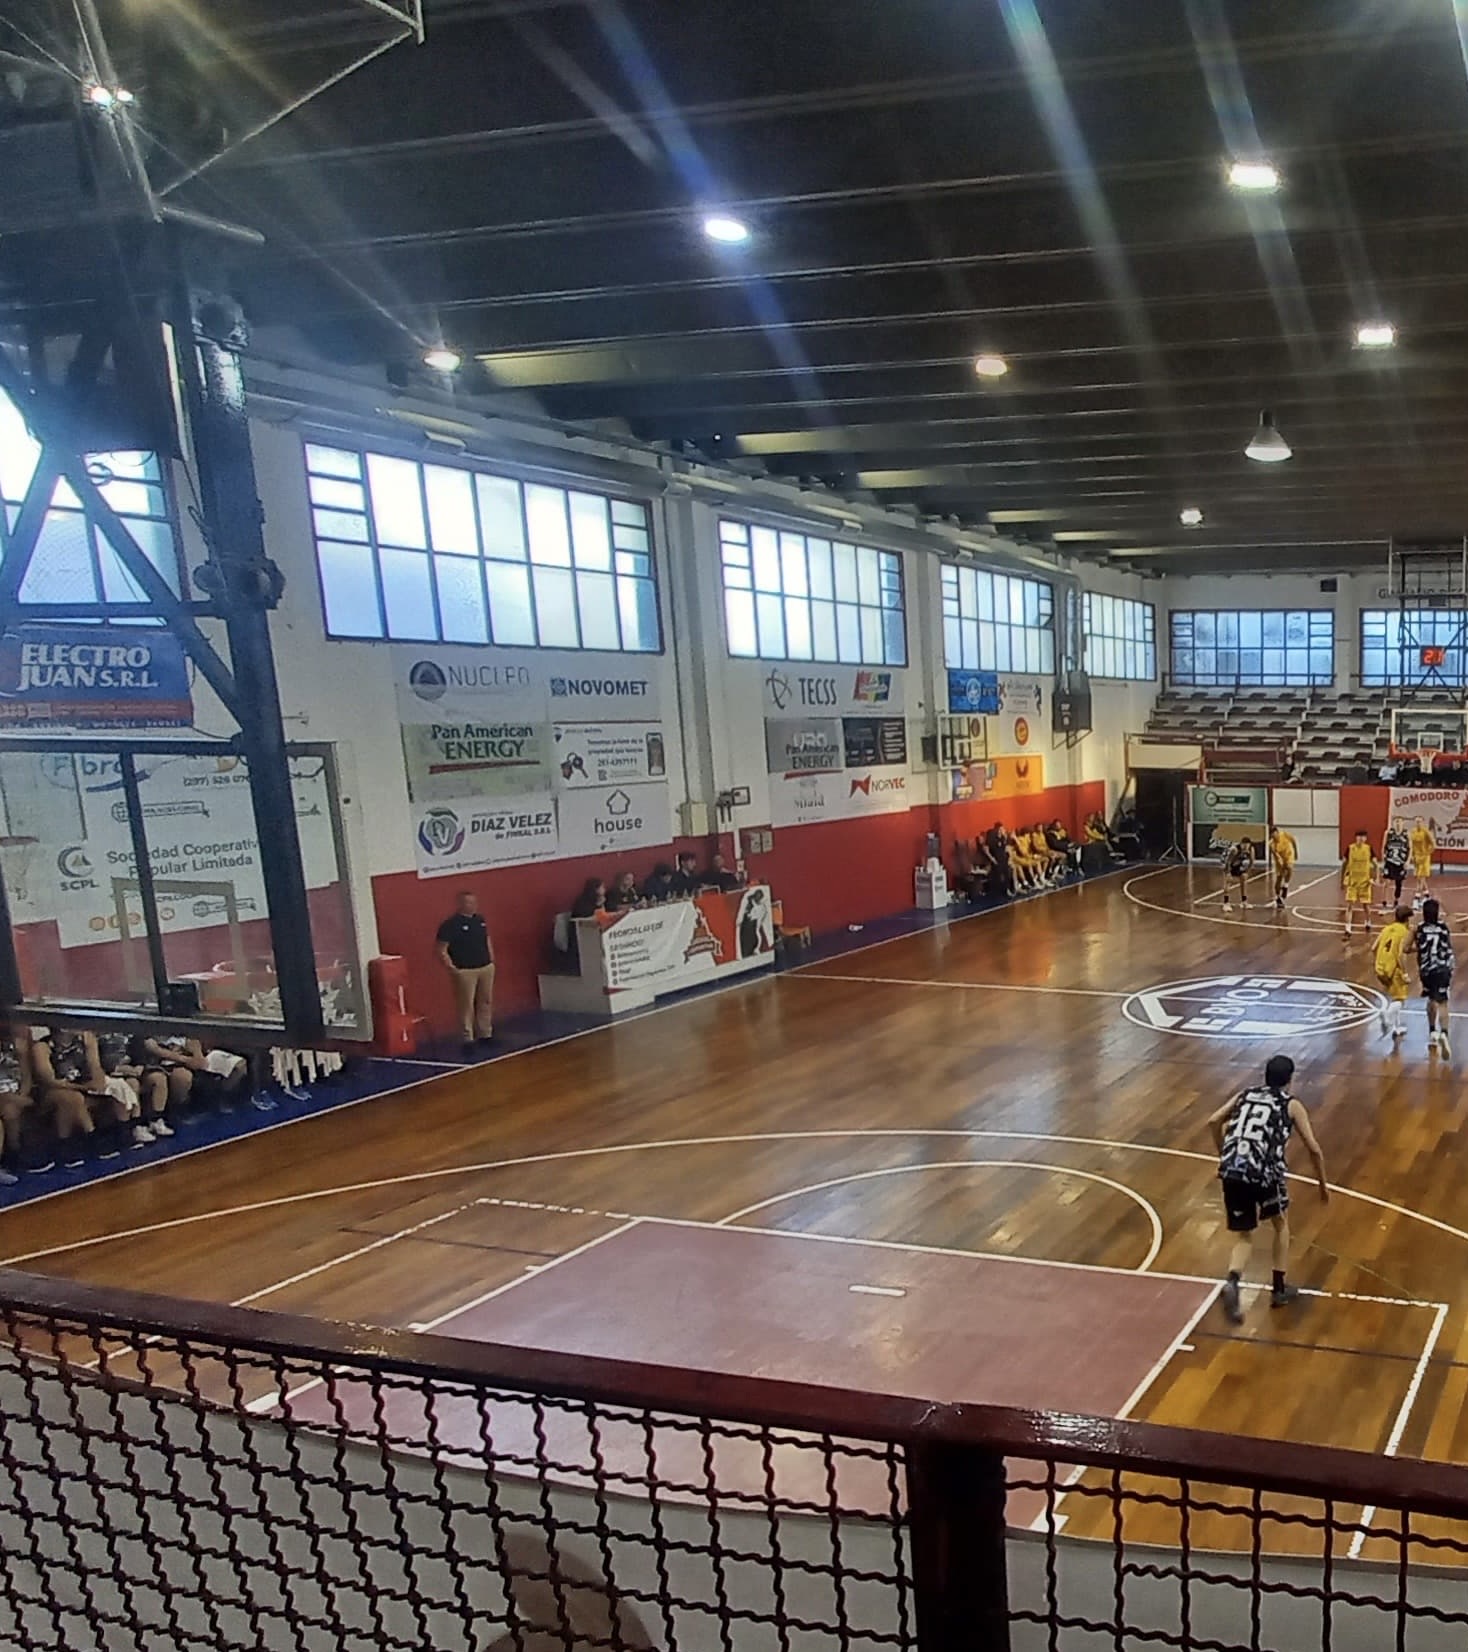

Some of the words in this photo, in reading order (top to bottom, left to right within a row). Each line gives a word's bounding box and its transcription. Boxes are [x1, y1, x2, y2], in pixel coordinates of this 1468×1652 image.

[21, 643, 151, 668] ELECTRO
[16, 665, 96, 692] JUAN
[567, 680, 648, 697] NOVOMET
[798, 678, 837, 706] TECSS
[431, 724, 461, 741] Pan
[464, 723, 533, 739] American
[444, 740, 525, 760] ENERGY
[792, 755, 834, 769] ENERGY
[1394, 791, 1460, 808] COMODORO
[471, 817, 505, 834] DIAZ
[509, 812, 552, 829] VELEZ
[594, 817, 643, 834] house
[107, 844, 178, 864] Socdad
[182, 839, 260, 858] Cooperativ
[129, 861, 188, 879] Ppular
[192, 855, 254, 871] Limitada
[60, 881, 99, 891] SCPL
[1382, 937, 1394, 953] 4
[1426, 933, 1440, 954] 7
[1233, 1103, 1272, 1141] 12
